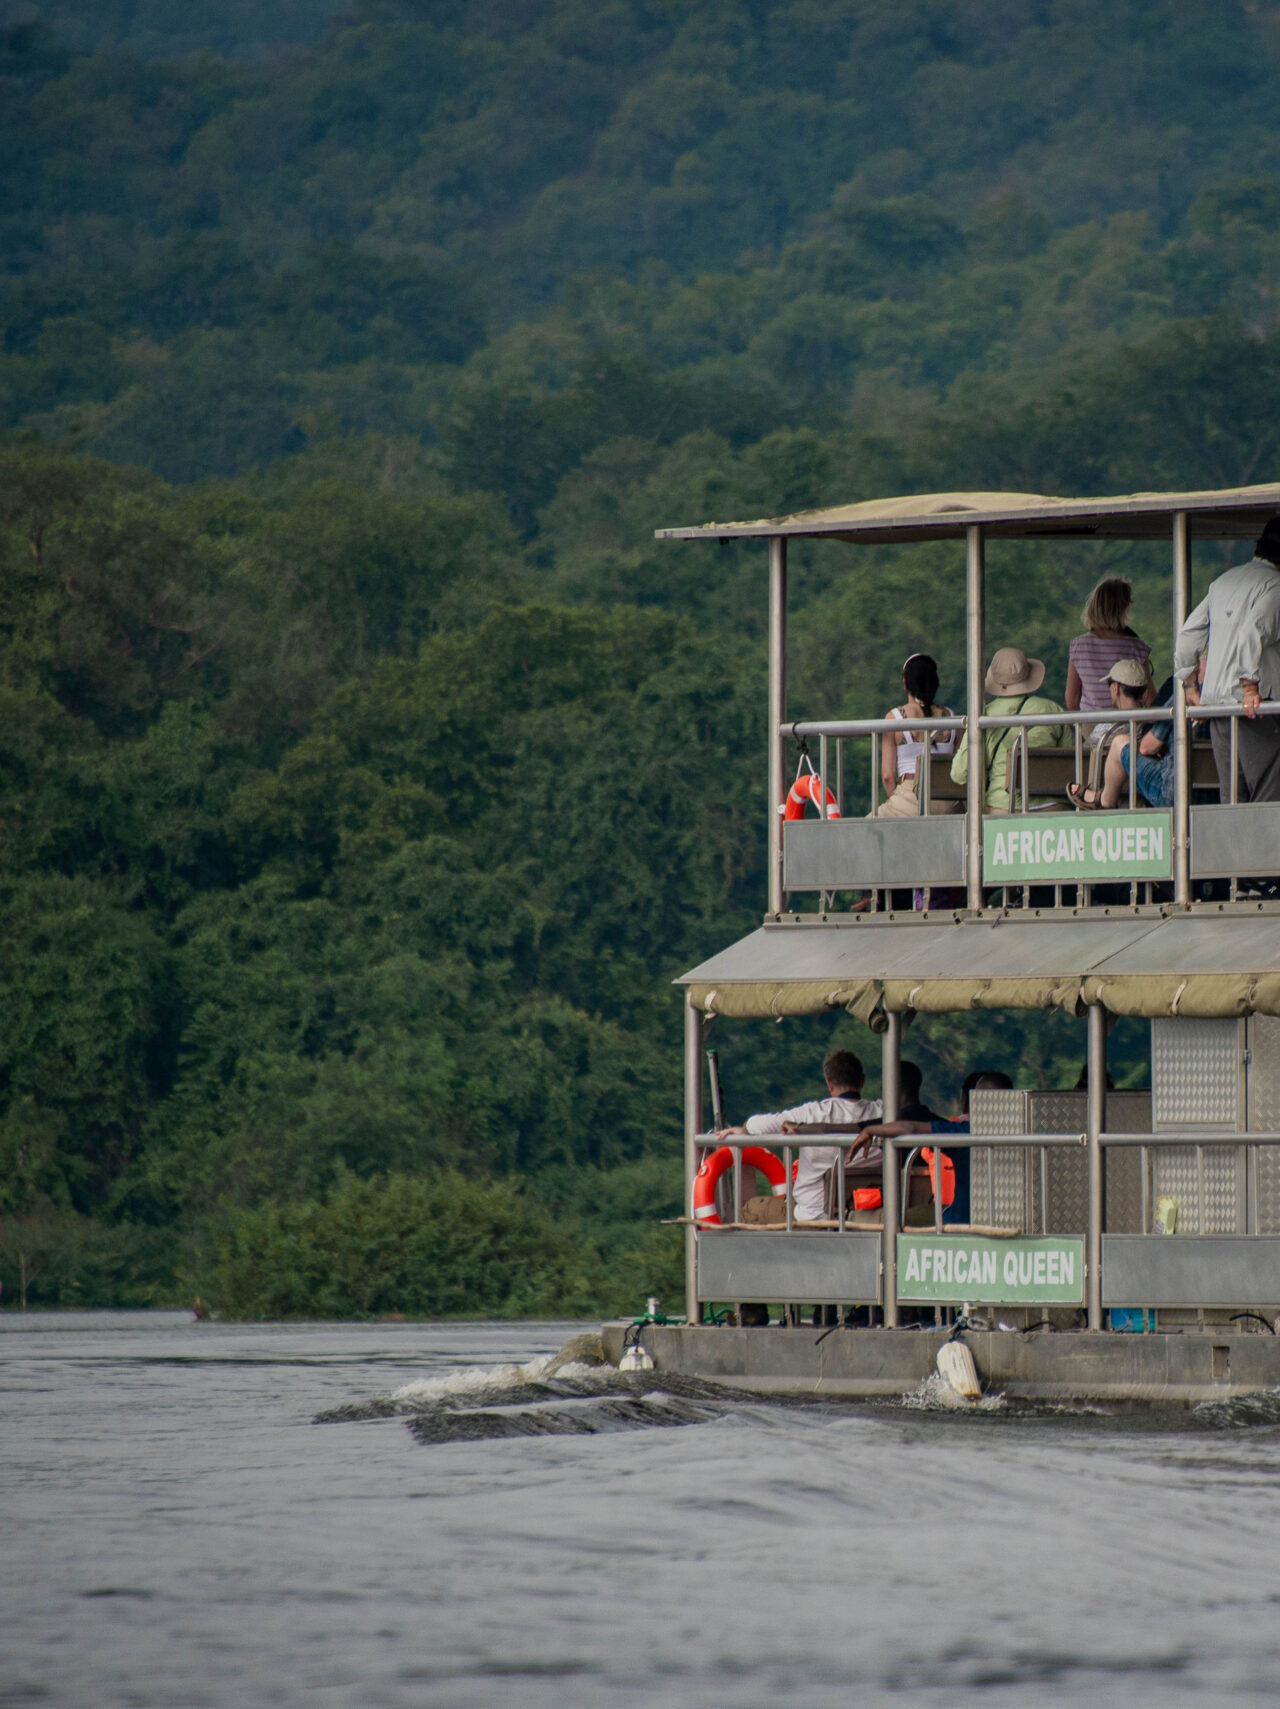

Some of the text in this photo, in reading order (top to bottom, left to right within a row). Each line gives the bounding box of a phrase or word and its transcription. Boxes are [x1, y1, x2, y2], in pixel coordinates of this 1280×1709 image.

[992, 827, 1163, 866] AFRICAN QUEEN
[905, 1248, 1074, 1287] AFRICAN QUEEN
